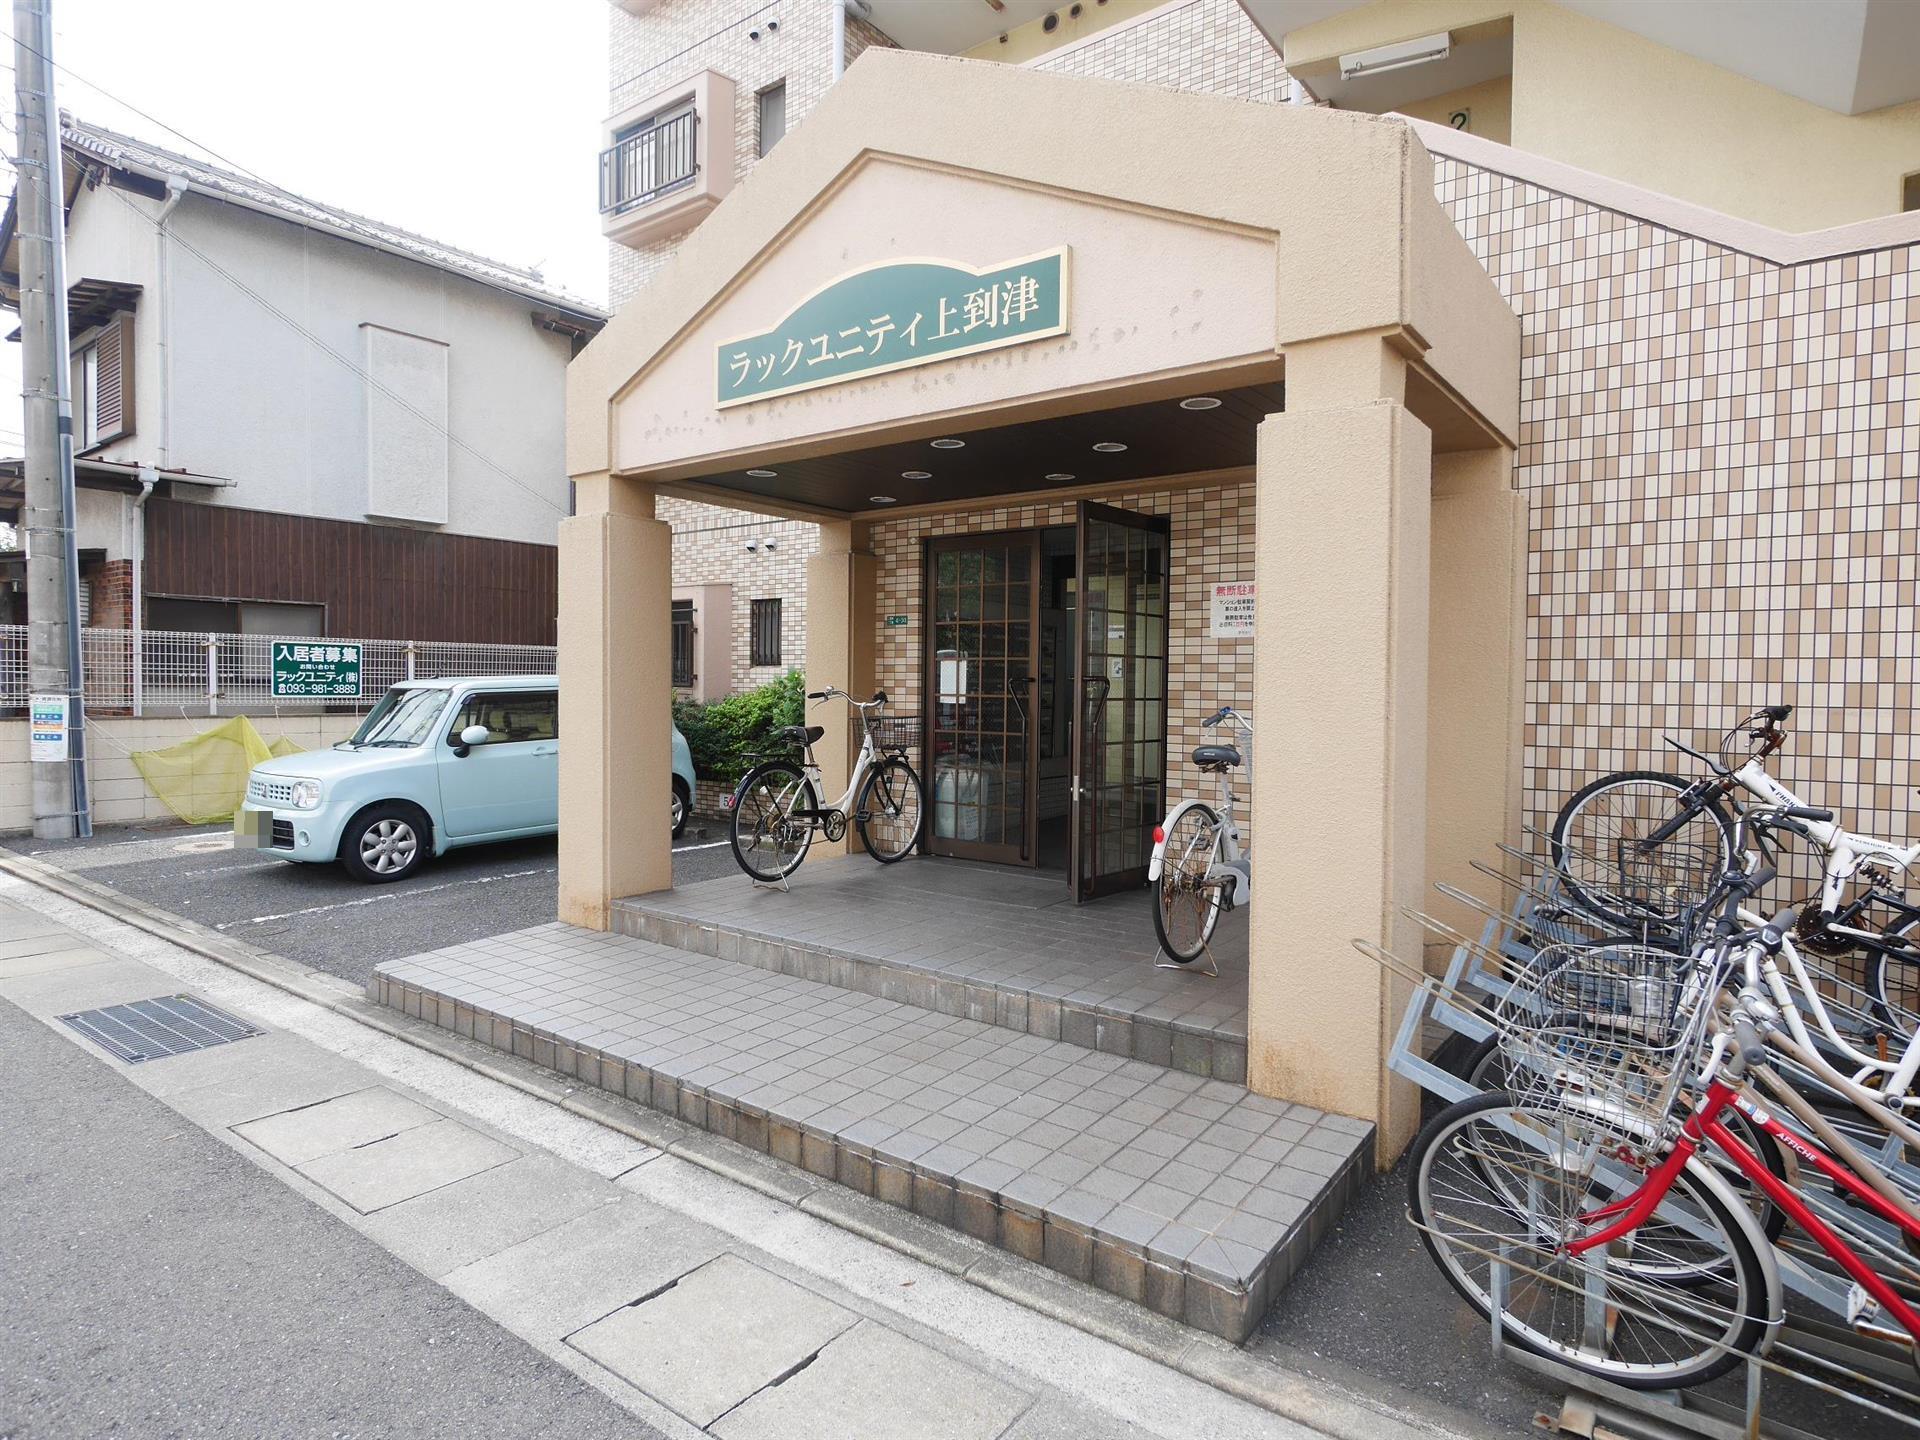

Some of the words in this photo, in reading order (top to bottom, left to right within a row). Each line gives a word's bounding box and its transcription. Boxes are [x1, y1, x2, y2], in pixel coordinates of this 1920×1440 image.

[729, 276, 1040, 388] ラックユニティ上到津
[276, 645, 358, 663] 入居者募集
[299, 663, 336, 671] お問い合わせ
[286, 683, 357, 694] 093-981-3889
[1775, 1131, 1818, 1163] AFFICHE
